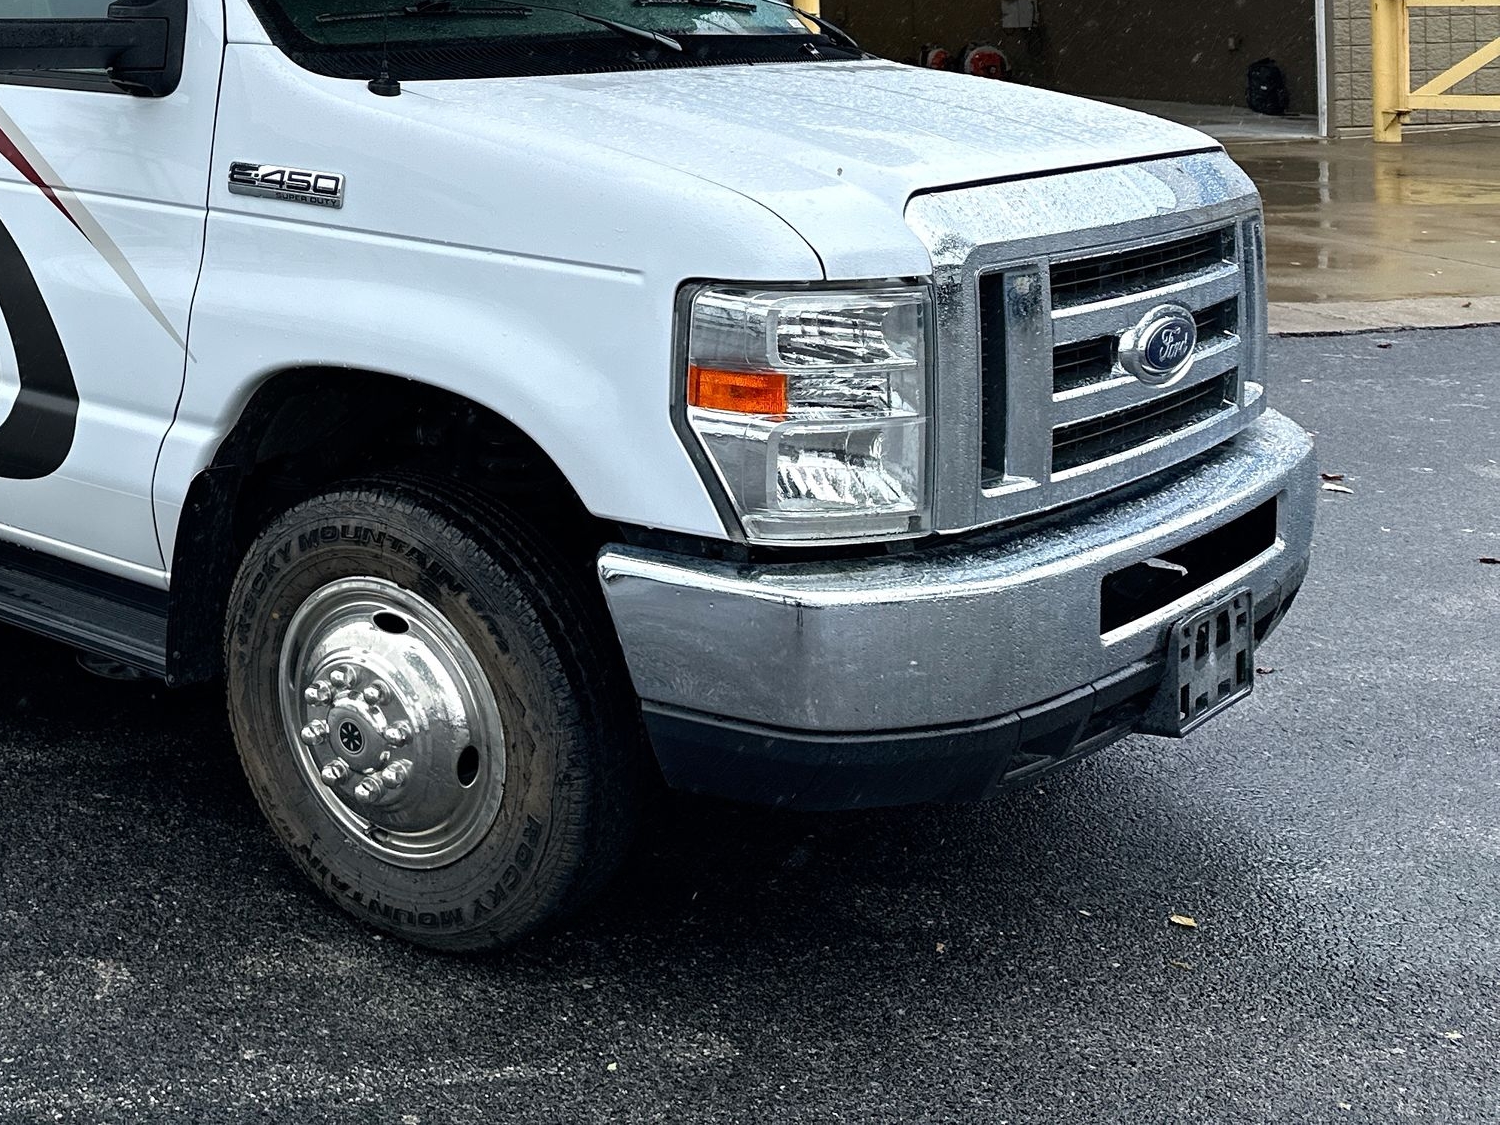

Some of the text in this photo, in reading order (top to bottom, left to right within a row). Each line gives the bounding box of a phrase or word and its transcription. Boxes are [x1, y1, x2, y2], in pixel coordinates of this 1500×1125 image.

[275, 192, 338, 208] SUPER DUTY
[1158, 326, 1189, 363] Ford
